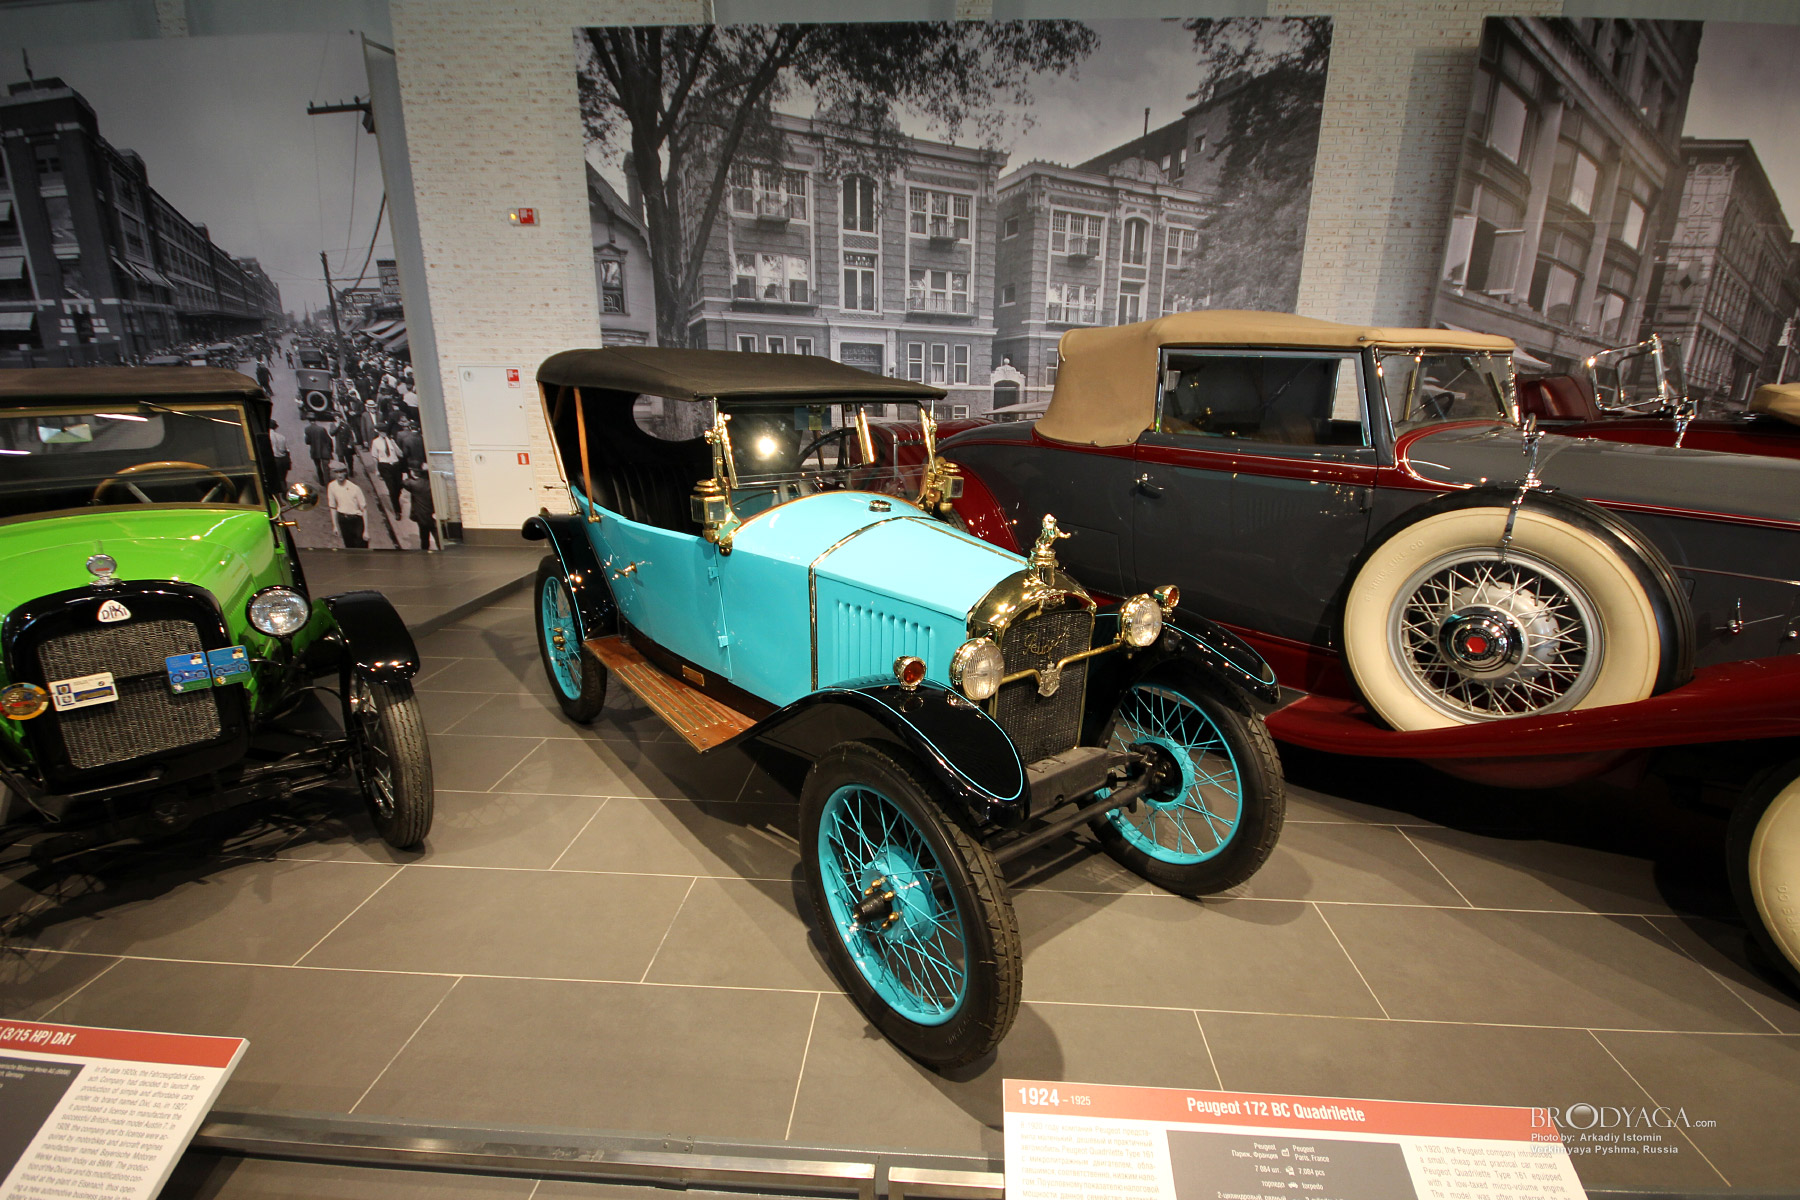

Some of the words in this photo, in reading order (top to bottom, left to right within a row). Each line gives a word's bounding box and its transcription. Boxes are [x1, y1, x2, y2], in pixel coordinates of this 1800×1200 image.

[101, 604, 128, 620] DIXI
[0, 1026, 32, 1042] (3/15
[28, 1029, 53, 1046] HP)
[50, 1031, 77, 1046] DA1
[1019, 1088, 1060, 1107] 1924
[1070, 1095, 1092, 1106] 1925
[1187, 1097, 1242, 1116] Peugeot
[1244, 1100, 1269, 1117] 172
[1273, 1102, 1291, 1118] BC
[1294, 1103, 1366, 1122] Quadrilette
[1254, 1142, 1276, 1151] Peugeot
[1292, 1144, 1314, 1153] Peugeot
[1456, 1147, 1486, 1156] Peugeot
[1485, 1150, 1517, 1158] company
[1516, 1150, 1553, 1158] introduced
[1449, 1158, 1472, 1167] cheap
[1488, 1160, 1519, 1169] practical
[1422, 1167, 1452, 1177] Peugeot
[1454, 1169, 1491, 1177] Quadrilette
[1494, 1171, 1512, 1180] Type
[1530, 1173, 1564, 1182] equipped
[1301, 1182, 1323, 1190] torpedo
[1454, 1180, 1488, 1188] low-taxed
[1491, 1182, 1539, 1191] micro-volume
[1431, 1190, 1445, 1199] The
[1450, 1191, 1471, 1200] model
